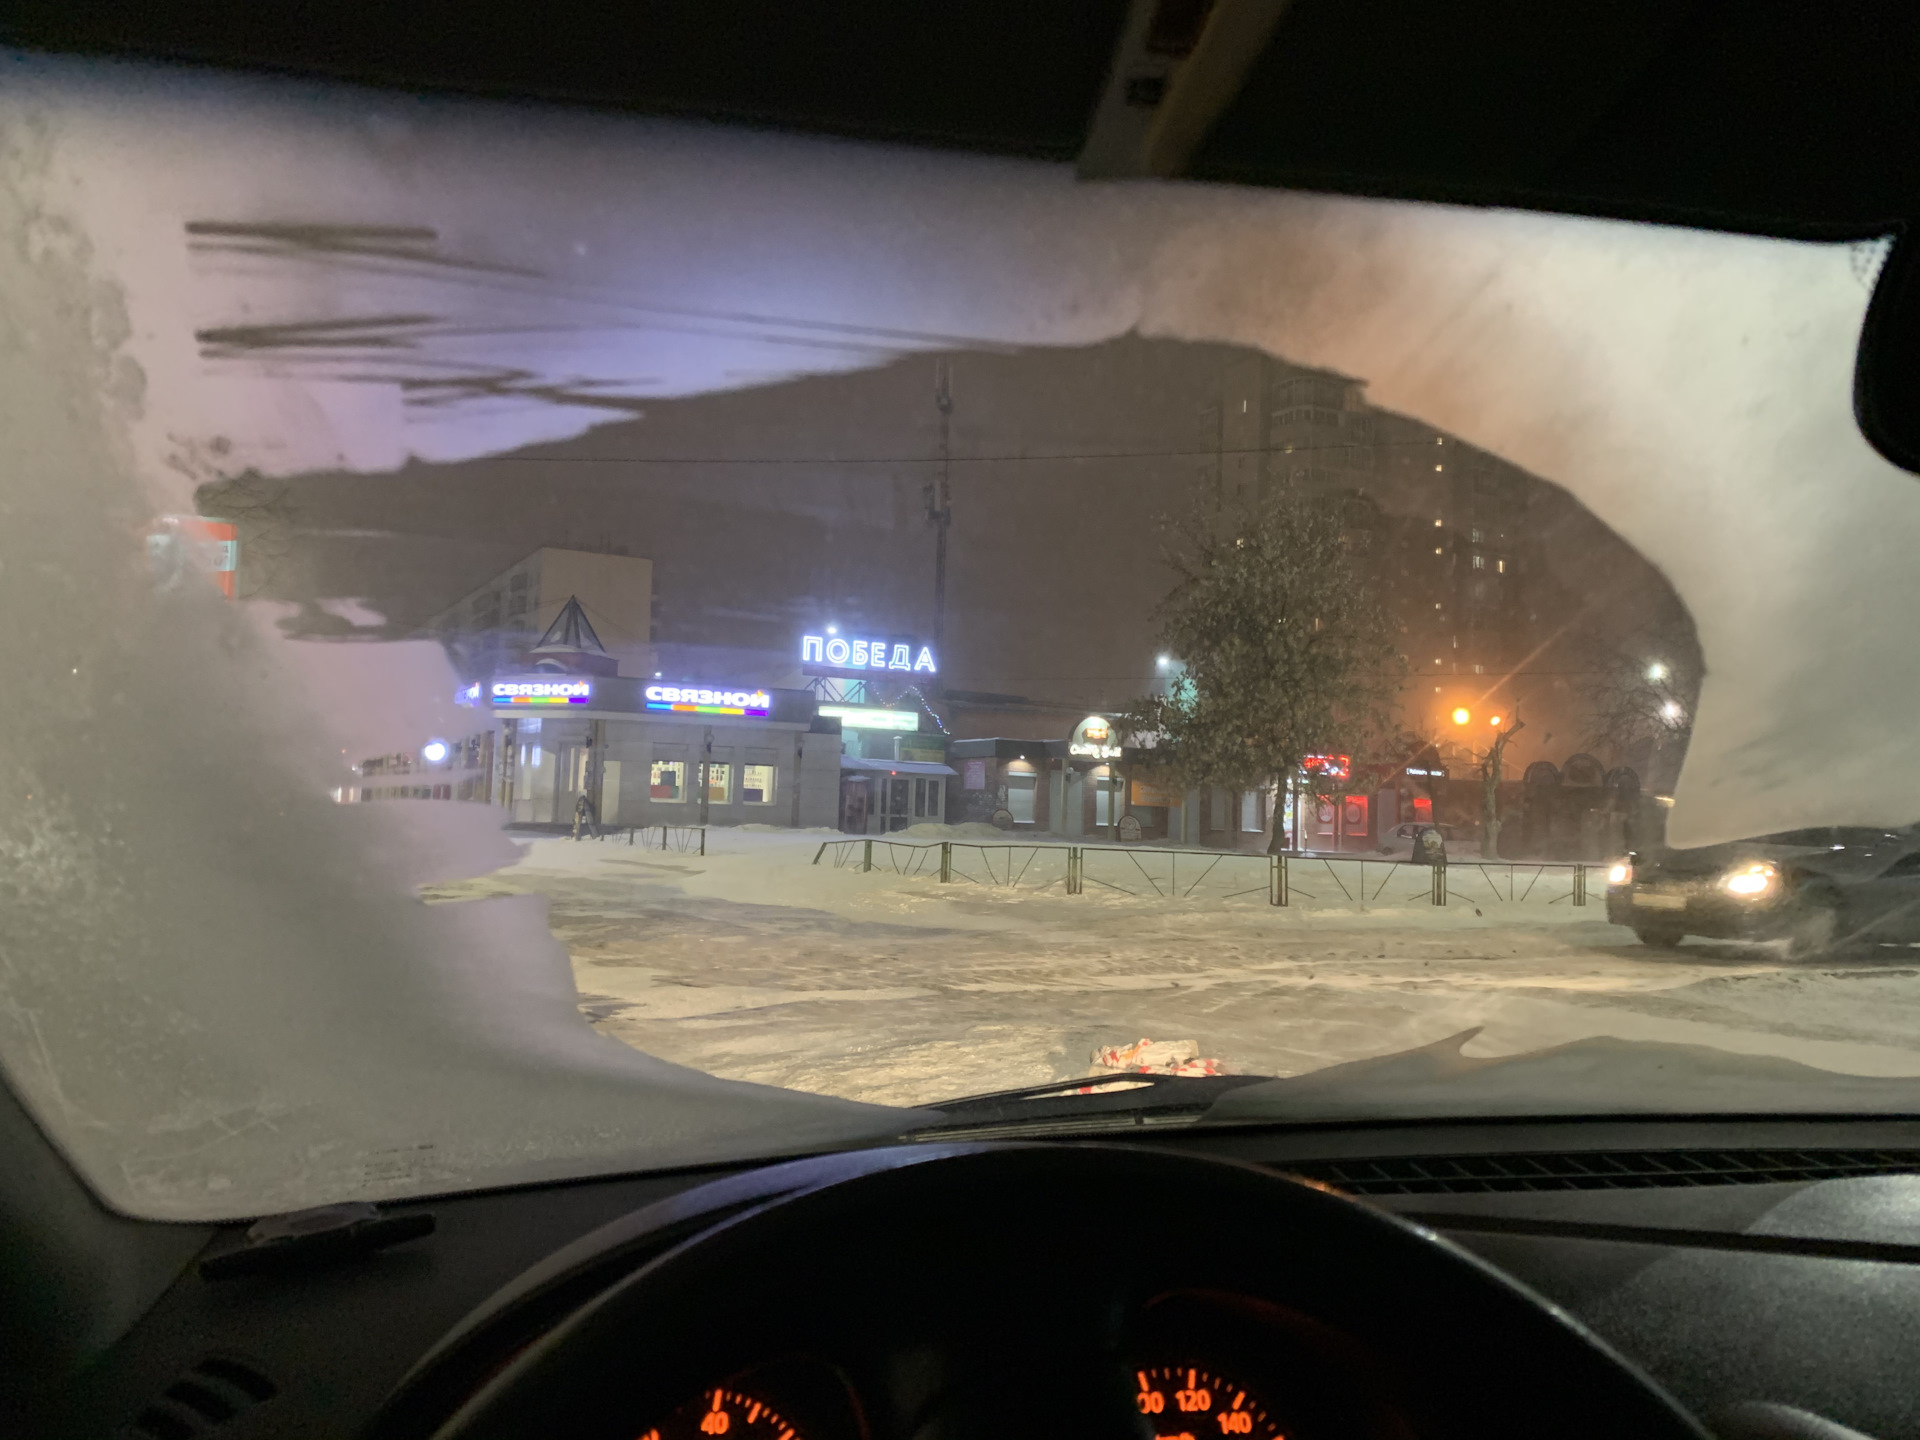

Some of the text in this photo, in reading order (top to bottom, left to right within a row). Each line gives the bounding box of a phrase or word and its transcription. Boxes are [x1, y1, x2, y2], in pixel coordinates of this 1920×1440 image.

[802, 635, 937, 672] ПОБЕДА
[492, 681, 590, 696] СВЯЗНОЙ
[645, 686, 770, 708] СВЯЗНОЙ
[1136, 1391, 1165, 1414] 00
[1175, 1389, 1211, 1412] 120
[700, 1411, 729, 1435] 40
[1217, 1411, 1252, 1435] 140
